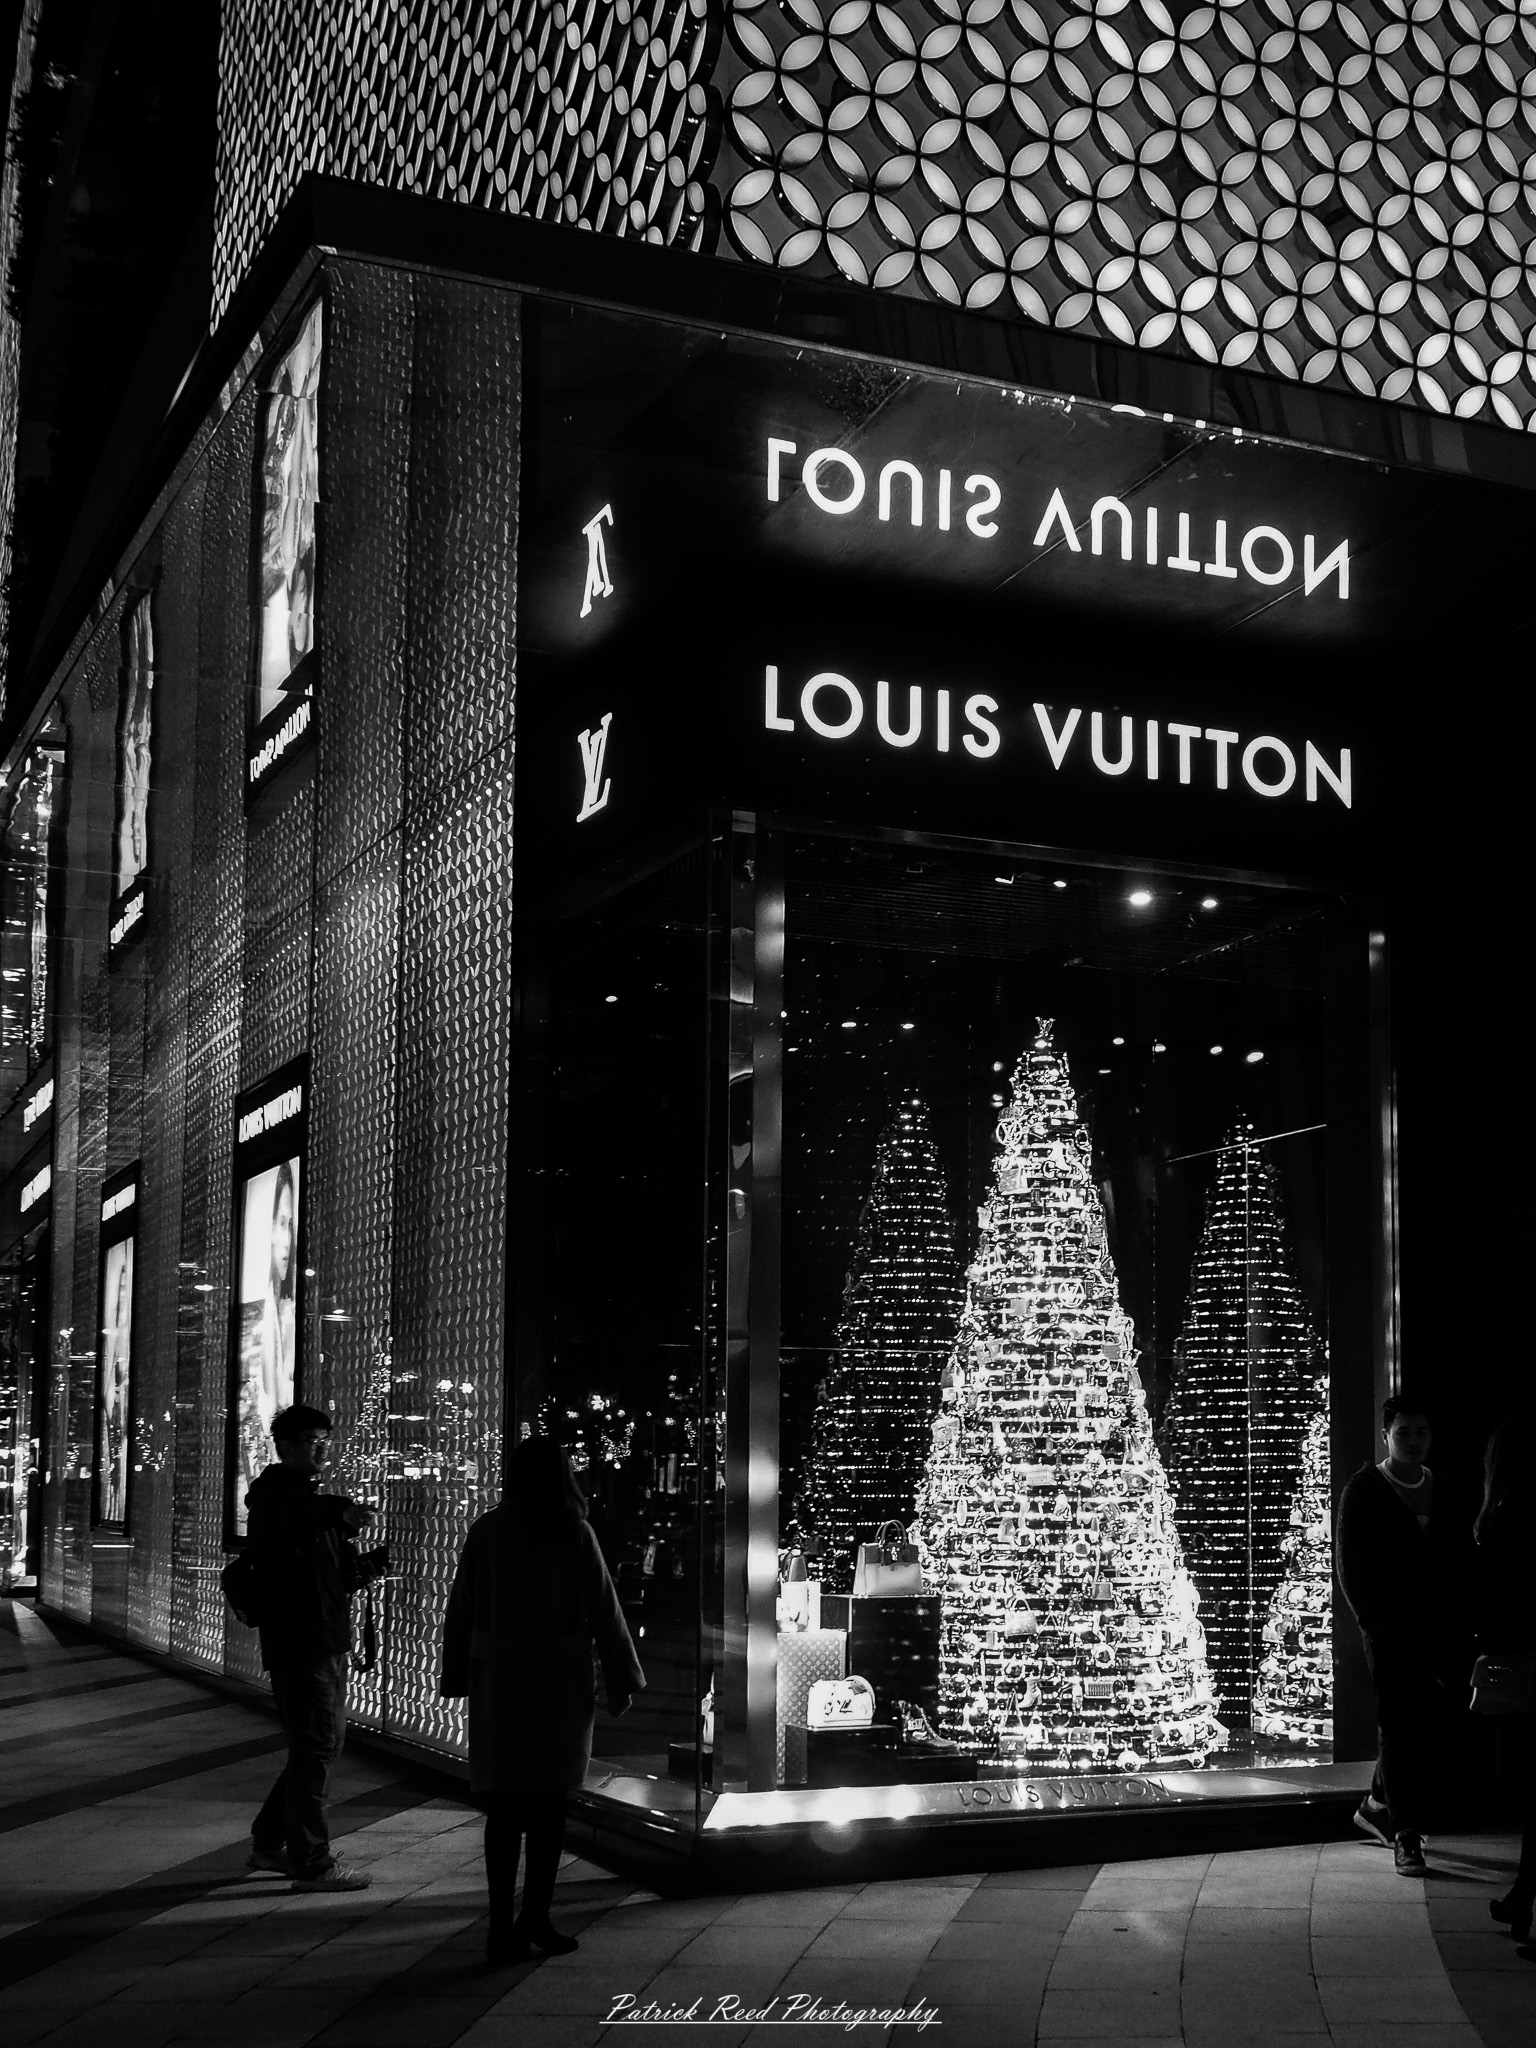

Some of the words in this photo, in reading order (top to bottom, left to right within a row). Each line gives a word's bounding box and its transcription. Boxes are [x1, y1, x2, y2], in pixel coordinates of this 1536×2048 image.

[765, 664, 1000, 759] LOUIS
[1032, 702, 1351, 809] VUITTON
[957, 1783, 1040, 1807] LOUIS
[1049, 1778, 1170, 1801] VUITTON
